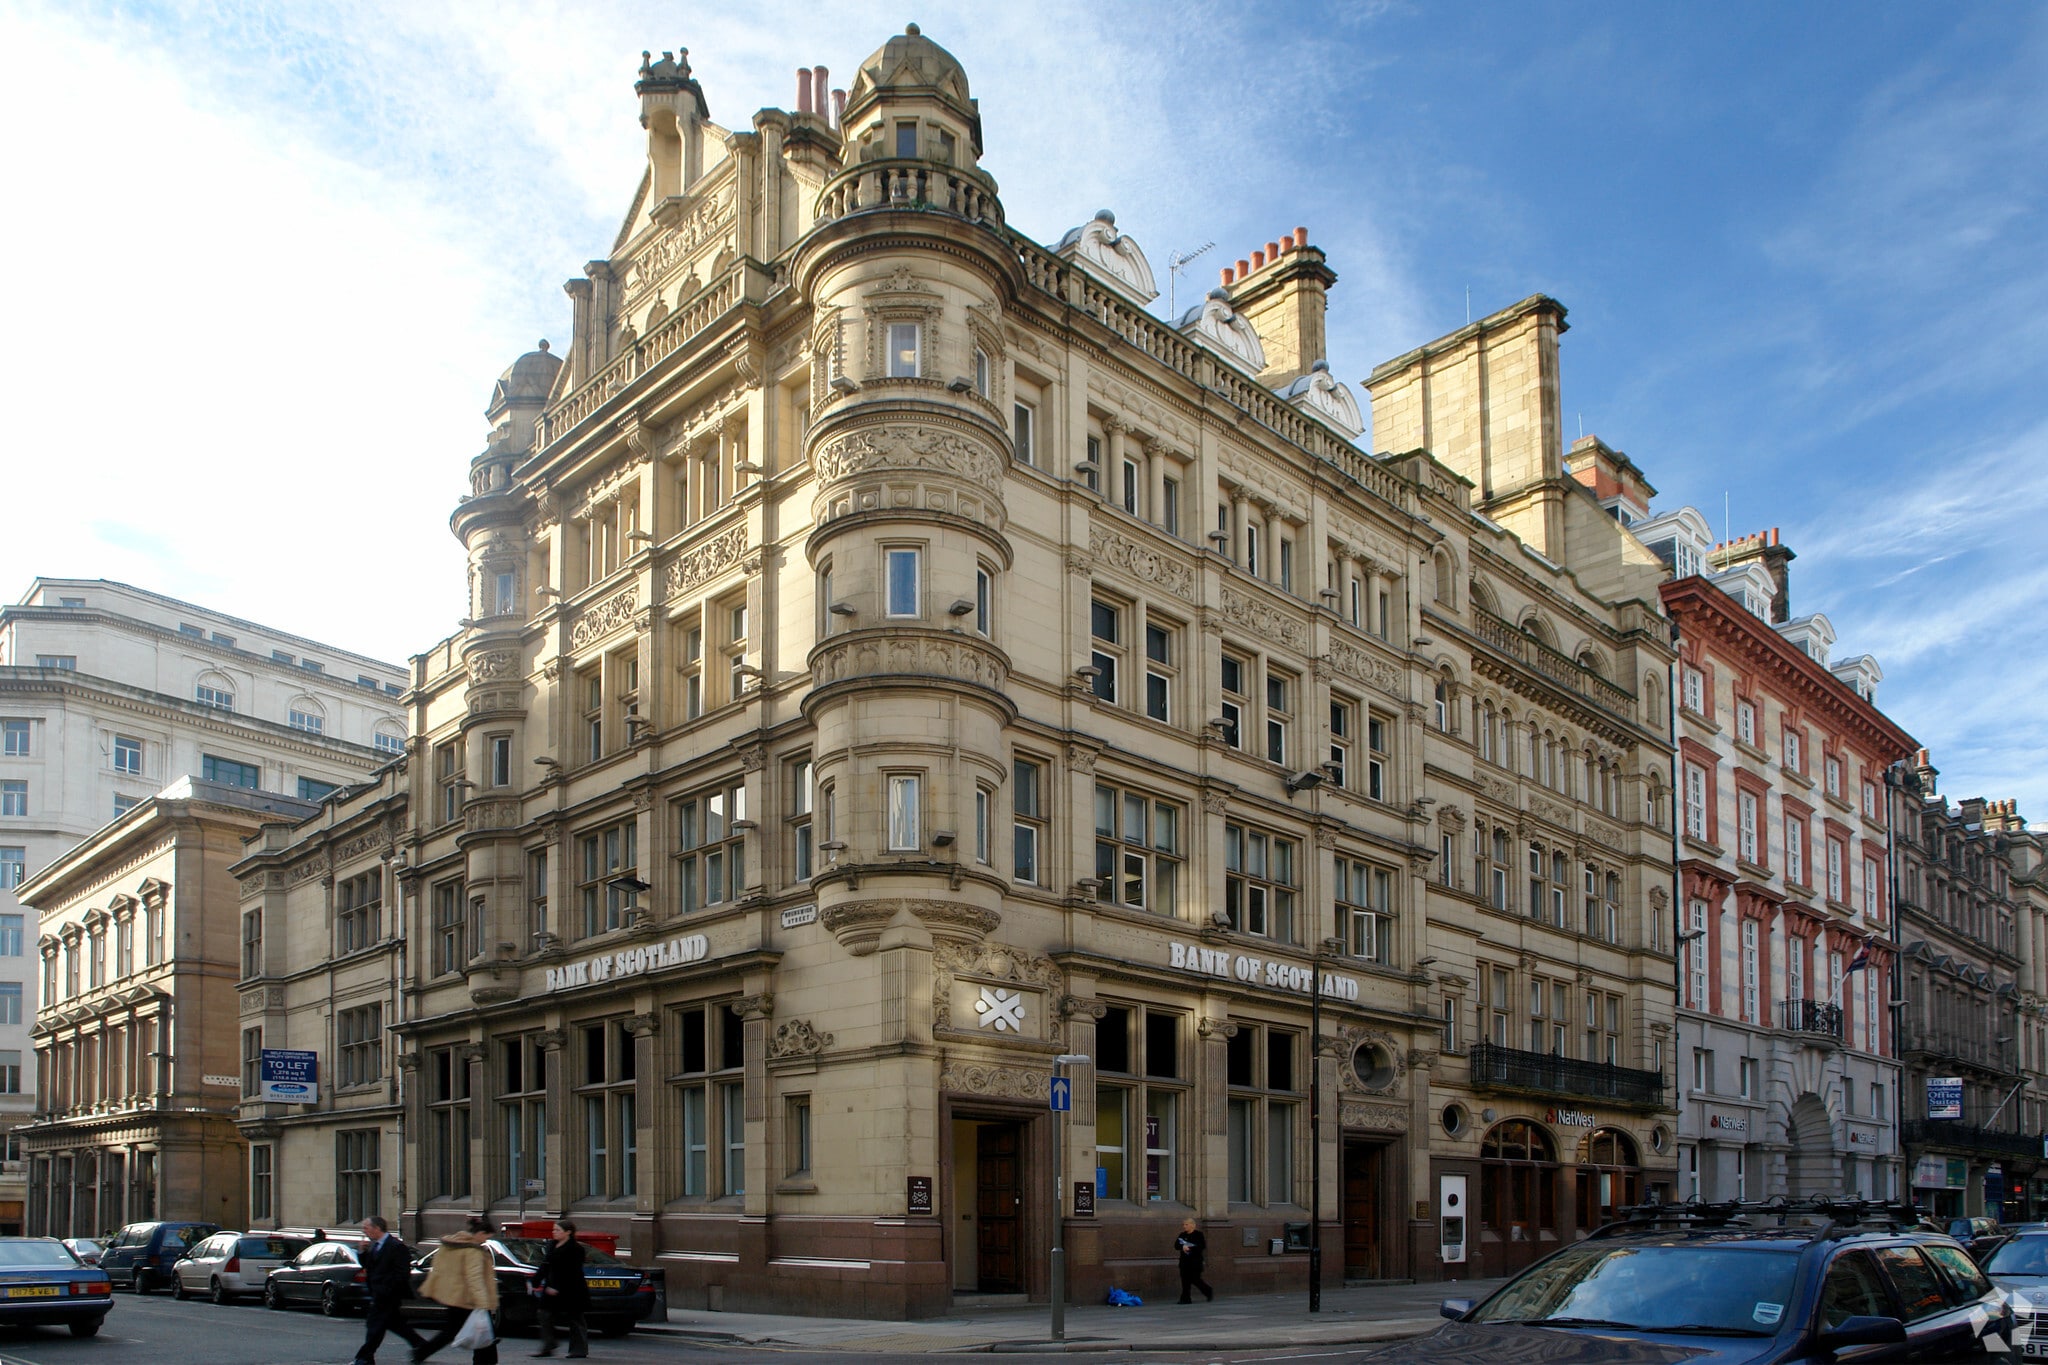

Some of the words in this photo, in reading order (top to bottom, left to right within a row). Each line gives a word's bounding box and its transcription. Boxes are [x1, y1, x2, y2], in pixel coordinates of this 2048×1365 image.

[788, 914, 810, 925] STREET
[546, 961, 589, 992] BANK
[591, 955, 613, 982] OF
[615, 934, 709, 978] SCOTLAND
[1169, 941, 1231, 978] BANK
[1235, 955, 1262, 983] OF
[268, 1061, 285, 1069] TO
[287, 1062, 309, 1070] LET
[1928, 1091, 1961, 1100] Office
[1558, 1109, 1596, 1127] NatWest
[1719, 1115, 1748, 1132] NatWest
